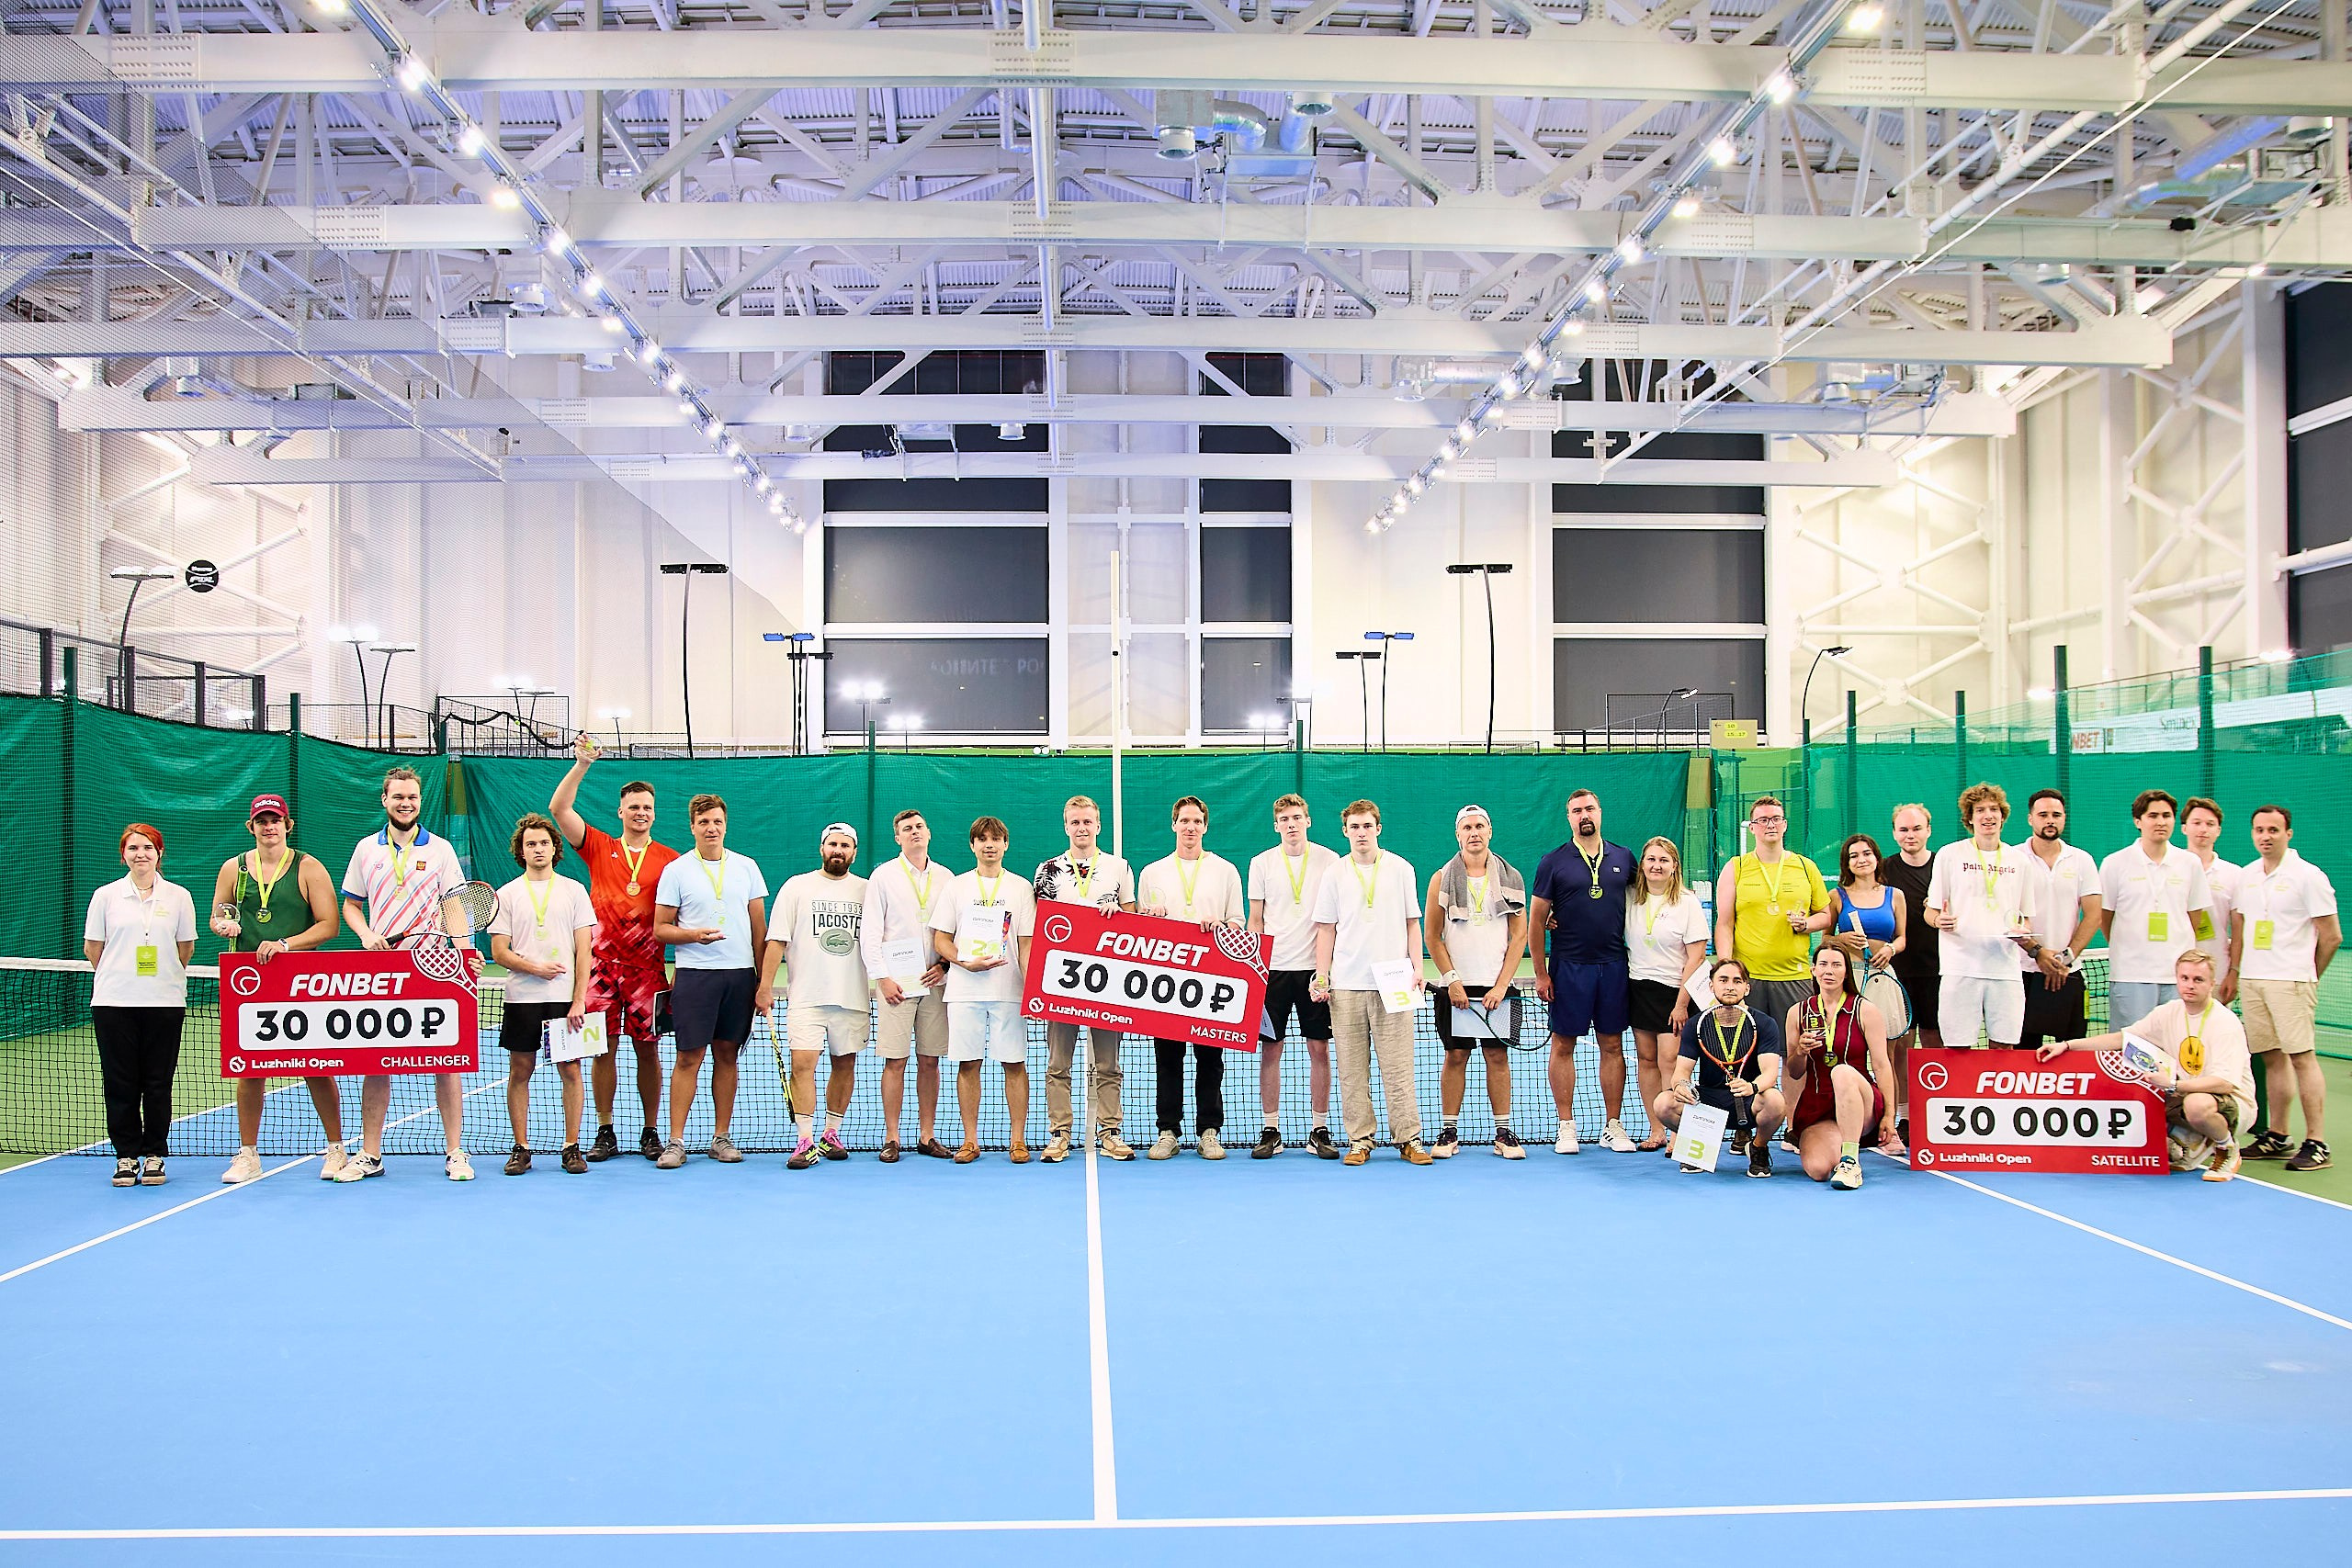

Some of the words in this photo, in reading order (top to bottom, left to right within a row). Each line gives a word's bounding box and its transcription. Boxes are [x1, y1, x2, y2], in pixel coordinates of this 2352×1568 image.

[2072, 731, 2100, 750] NBET
[811, 902, 837, 912] SINCE
[842, 903, 863, 915] 1933
[971, 940, 988, 956] 2
[1096, 931, 1210, 967] FONBET
[289, 972, 411, 998] FONBET
[1057, 958, 1109, 994] 30
[1048, 1002, 1099, 1020] Luzhniki
[1101, 1011, 1133, 1025] Open
[254, 1010, 309, 1042] 30
[1190, 1024, 1248, 1043] MASTERS
[251, 1057, 306, 1069] Luzhniki
[309, 1057, 345, 1069] Open
[380, 1055, 470, 1067] CHALLENGER
[1976, 1071, 2096, 1095] FONBET
[1943, 1106, 1995, 1135] 30
[1688, 1139, 1705, 1159] 3
[1939, 1153, 1994, 1164] Luzhniki
[1996, 1154, 2032, 1165] Open
[2091, 1155, 2160, 1168] SATELLITE
